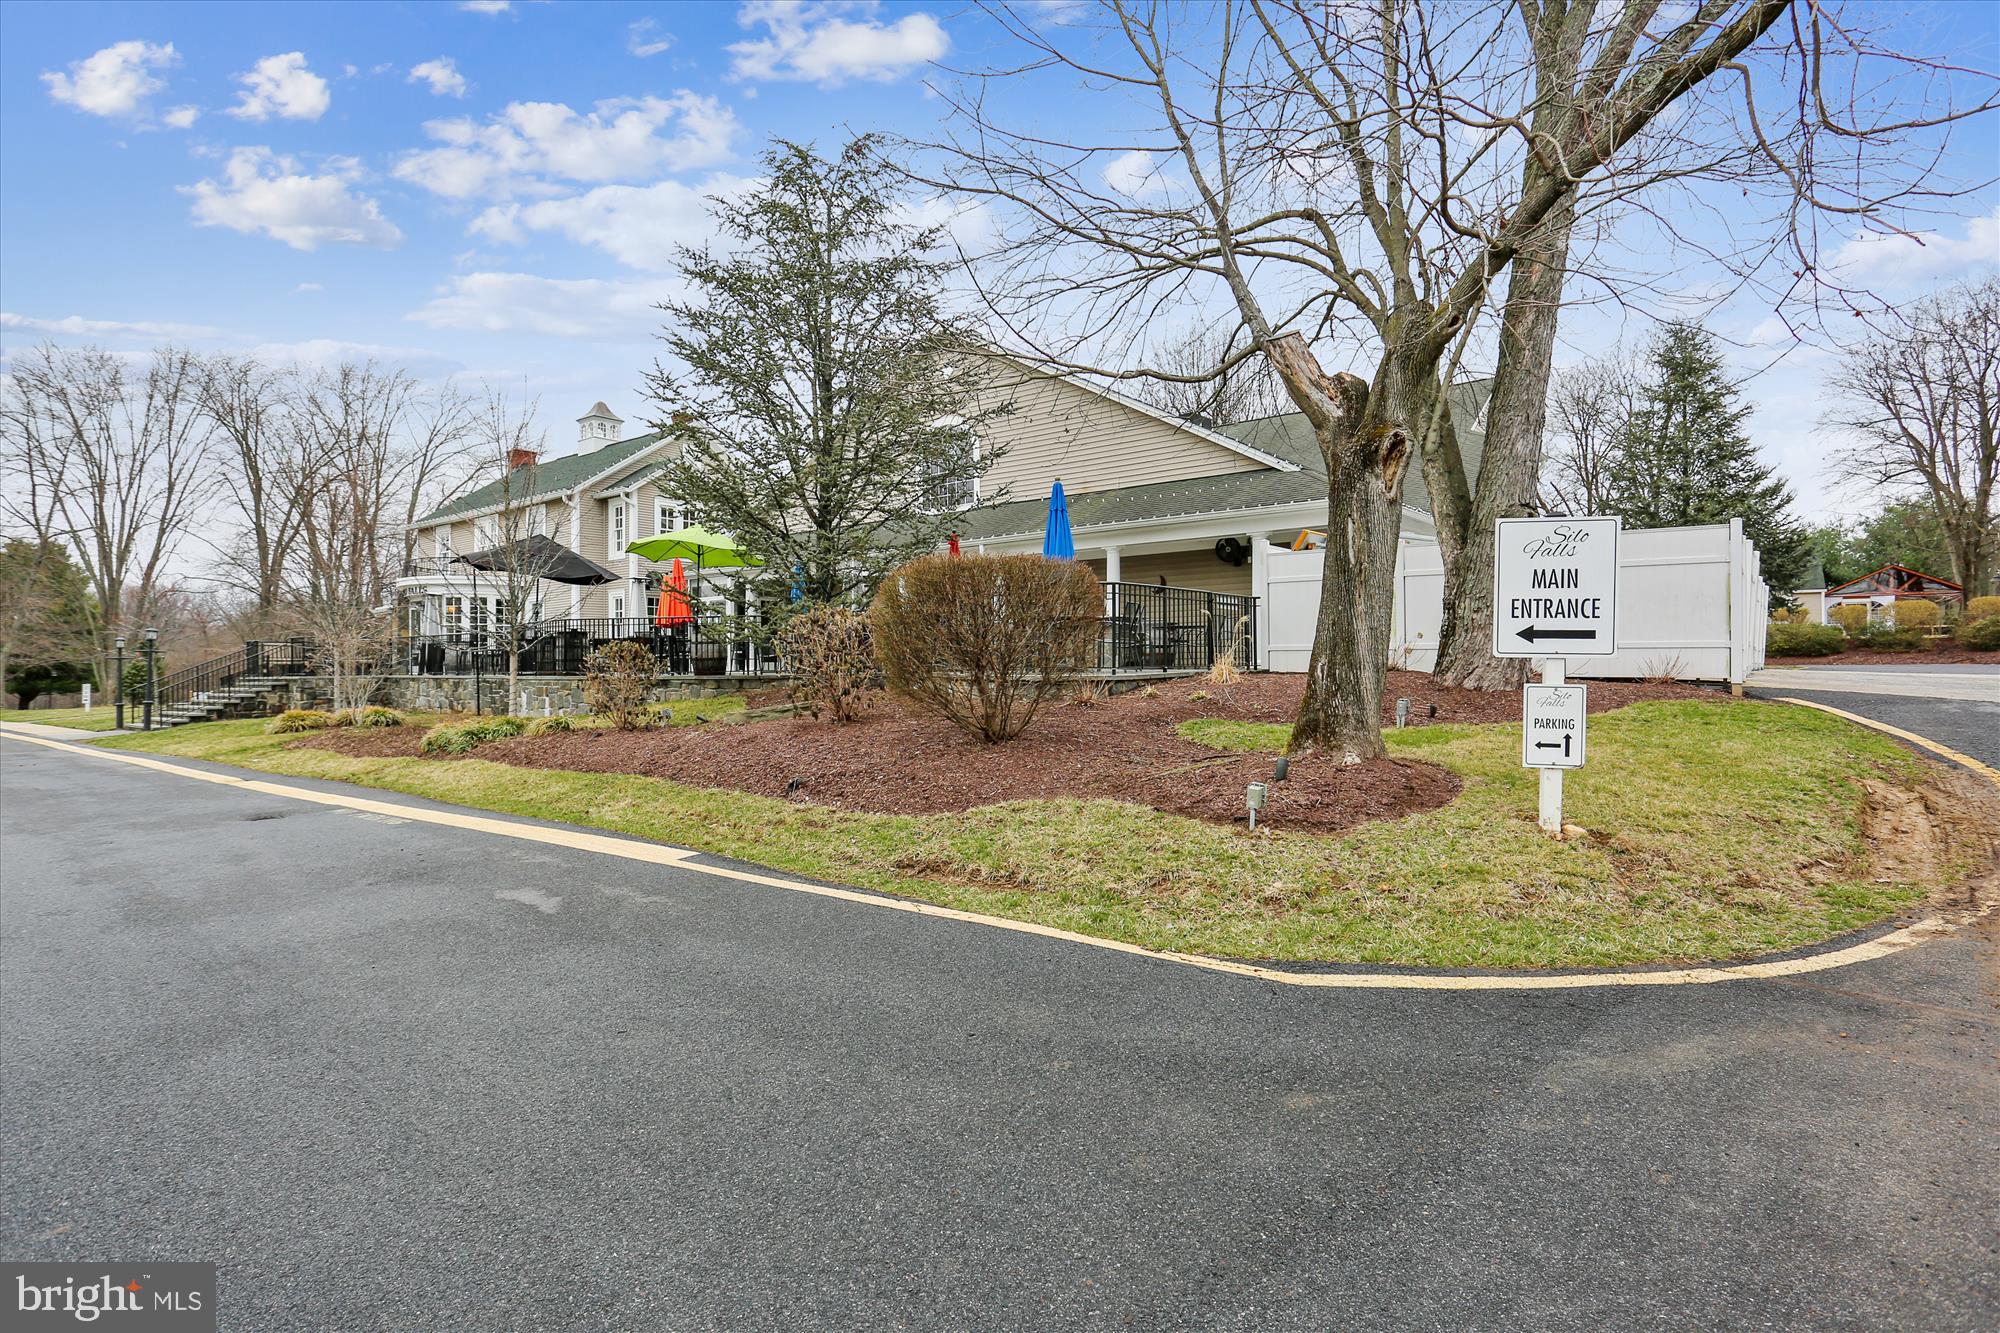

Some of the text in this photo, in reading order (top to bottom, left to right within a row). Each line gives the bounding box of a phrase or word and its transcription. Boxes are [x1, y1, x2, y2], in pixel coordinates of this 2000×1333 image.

[1546, 525, 1590, 545] Silo
[1523, 539, 1577, 559] Falls
[1532, 568, 1579, 589] MAIN
[1511, 598, 1601, 619] ENTRANCE
[1534, 717, 1575, 730] PARKING
